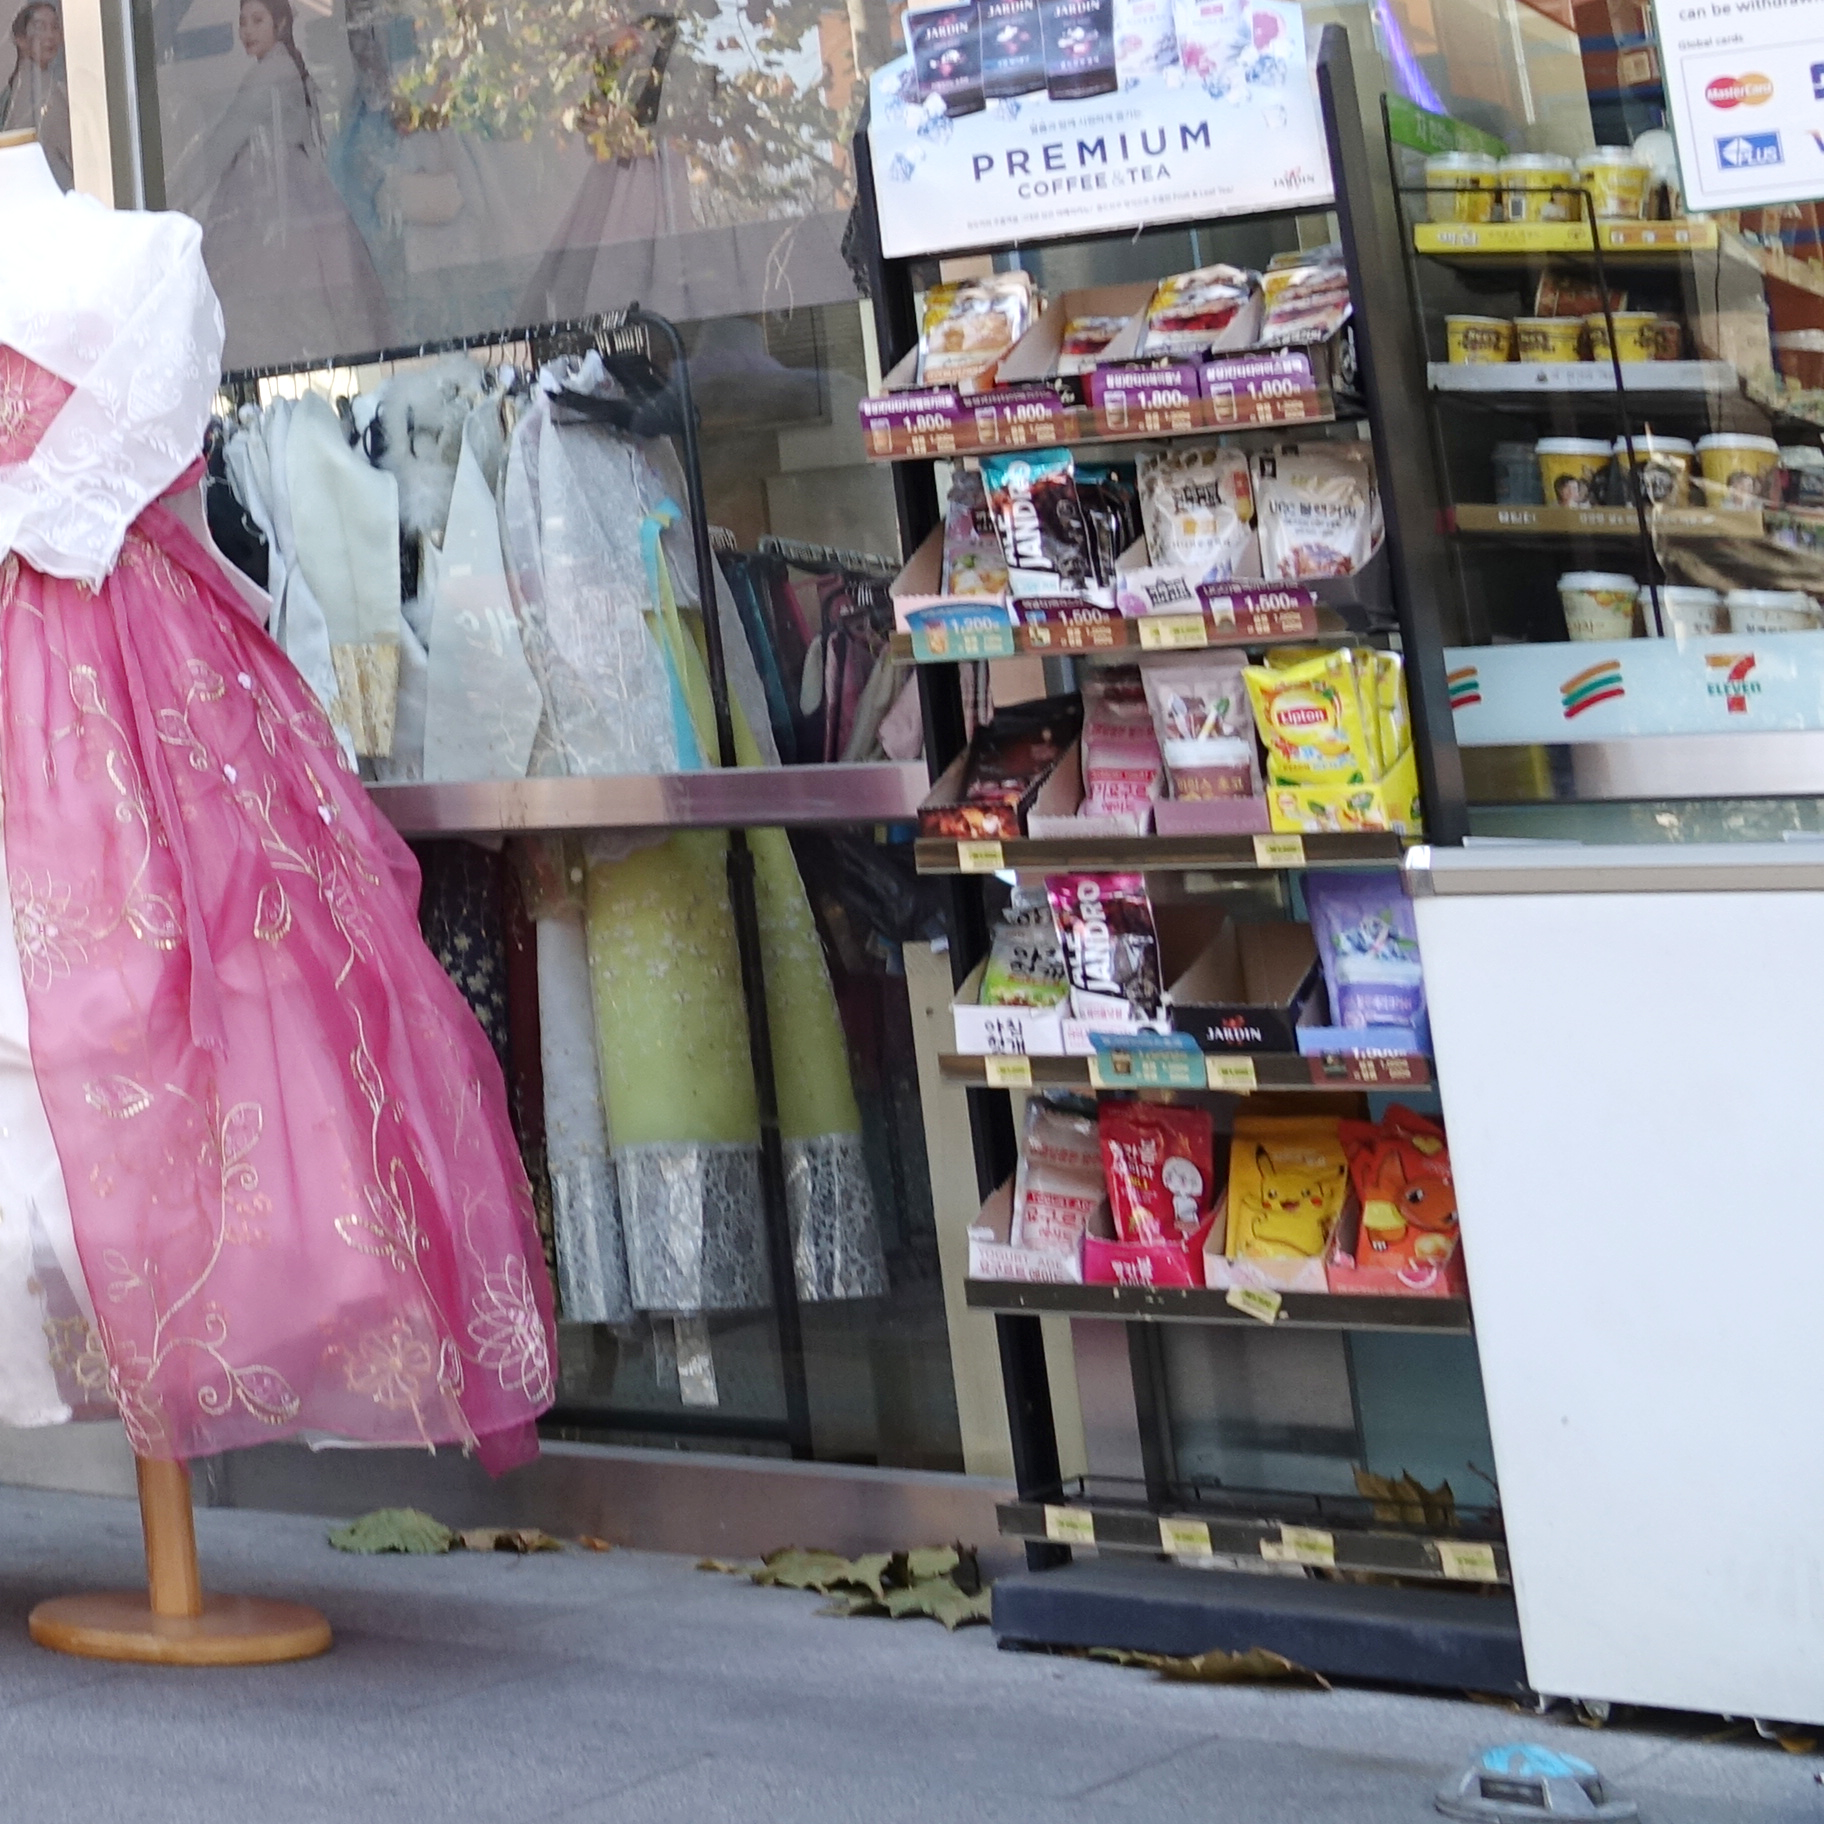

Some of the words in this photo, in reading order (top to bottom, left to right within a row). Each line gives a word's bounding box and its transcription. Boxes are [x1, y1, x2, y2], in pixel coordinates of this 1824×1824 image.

[1679, 8, 1707, 22] can
[1711, 1, 1732, 17] be
[925, 22, 969, 42] JARDIN
[971, 120, 1213, 183] PREMIUM
[1279, 706, 1327, 725] Lipton
[1077, 880, 1121, 994] JANDRO
[1206, 1024, 1263, 1044] JARDIN
